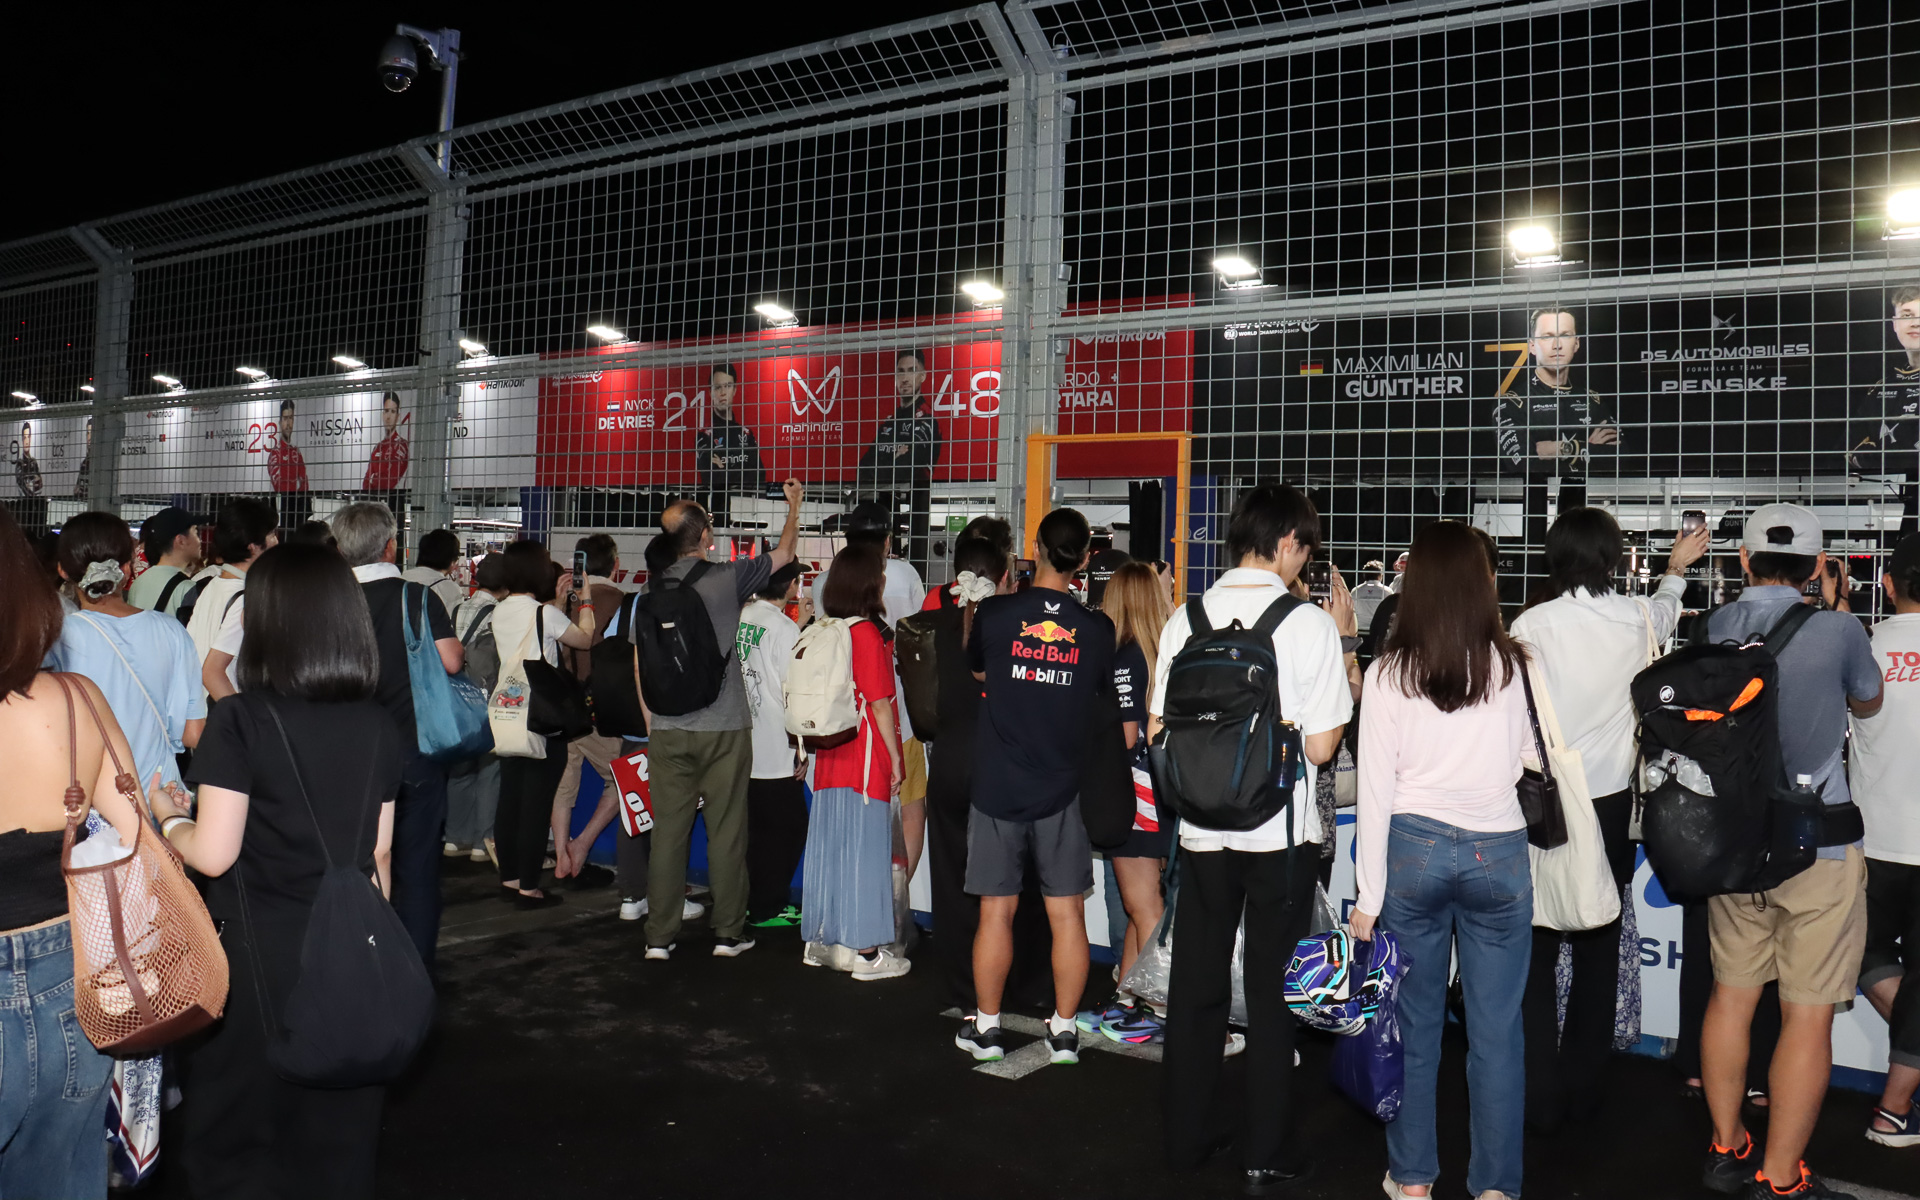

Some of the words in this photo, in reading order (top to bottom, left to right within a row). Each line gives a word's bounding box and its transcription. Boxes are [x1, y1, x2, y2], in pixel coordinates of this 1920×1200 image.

[1335, 352, 1464, 373] MAXIMILIAN
[1641, 350, 1668, 361] DS
[1671, 344, 1810, 360] AUTOMOBILES
[1484, 342, 1529, 397] 7
[934, 370, 1001, 418] 48
[1345, 375, 1464, 398] GÜNTHER
[1661, 376, 1788, 395] PENSKE
[624, 399, 656, 411] NYCK
[662, 390, 706, 432] 21
[310, 417, 363, 437] NISSAN
[598, 417, 616, 430] DE
[617, 415, 655, 429] VRIES
[225, 441, 245, 451] NATO
[248, 422, 278, 454] 23
[10, 440, 20, 464] 9
[1011, 640, 1046, 660] Red
[1046, 645, 1080, 665] Bull
[1011, 664, 1055, 684] Mobil
